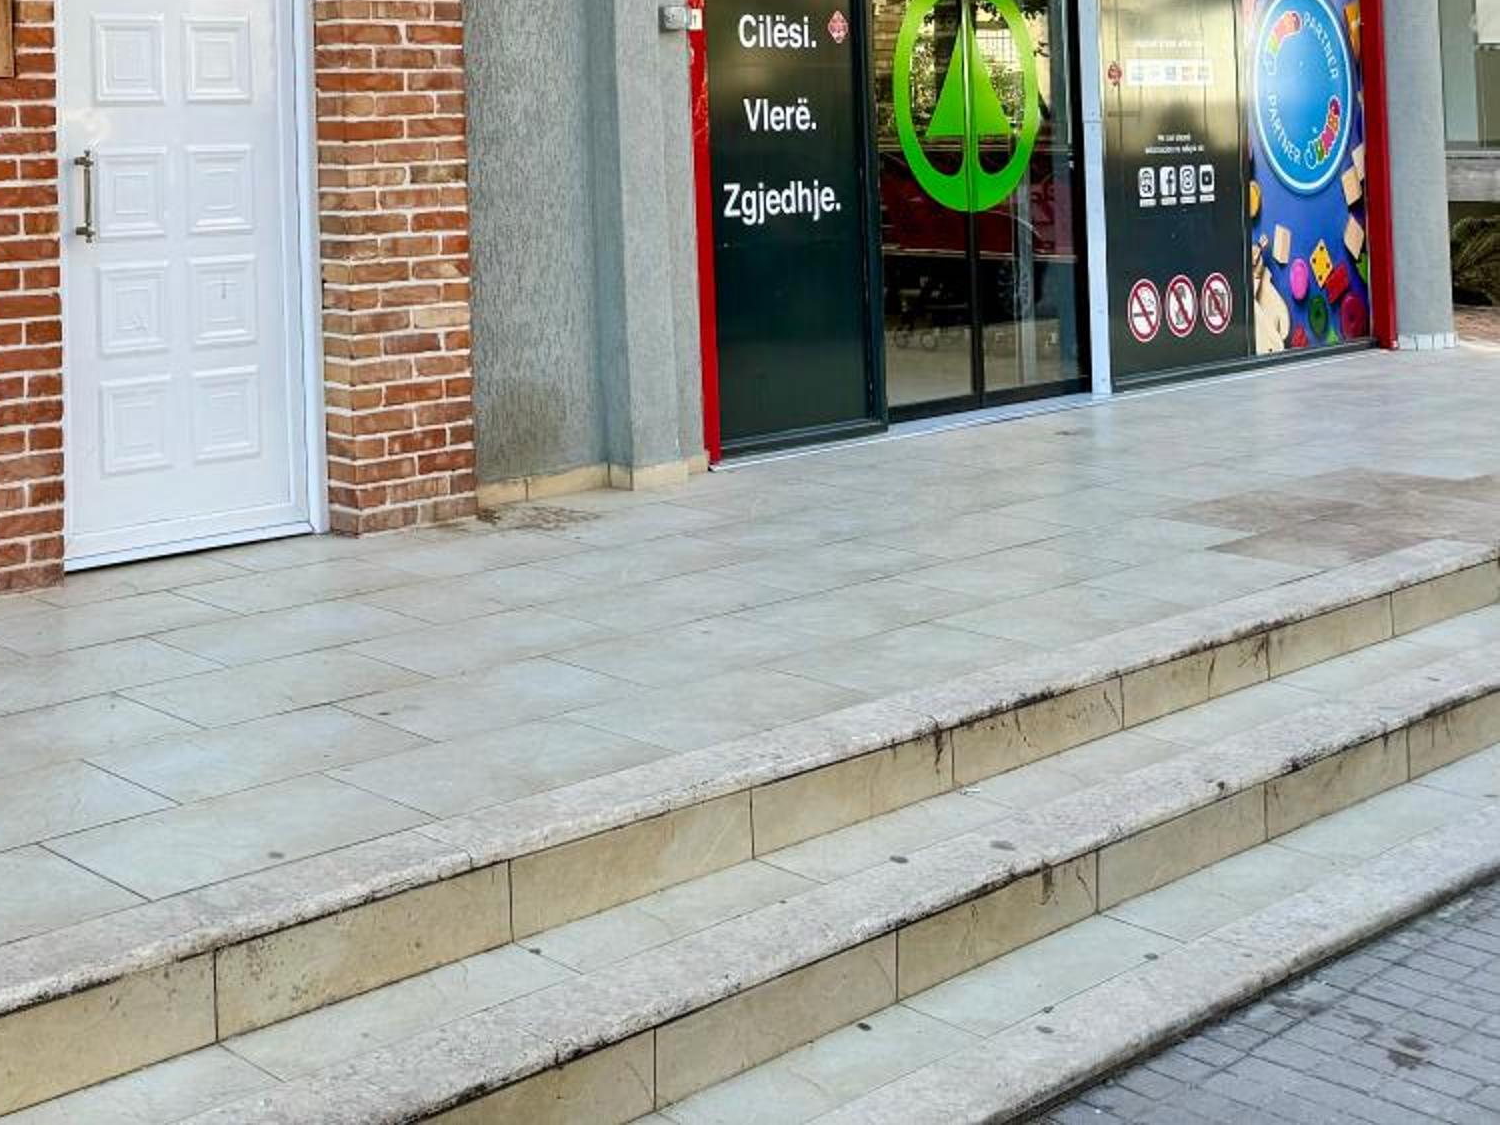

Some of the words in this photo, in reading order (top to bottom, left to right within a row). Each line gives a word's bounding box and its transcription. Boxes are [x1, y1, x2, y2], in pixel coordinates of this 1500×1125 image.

[738, 14, 817, 49] Cilësi.
[743, 98, 817, 132] Vlerë.
[723, 180, 841, 226] Zgjedhje.
